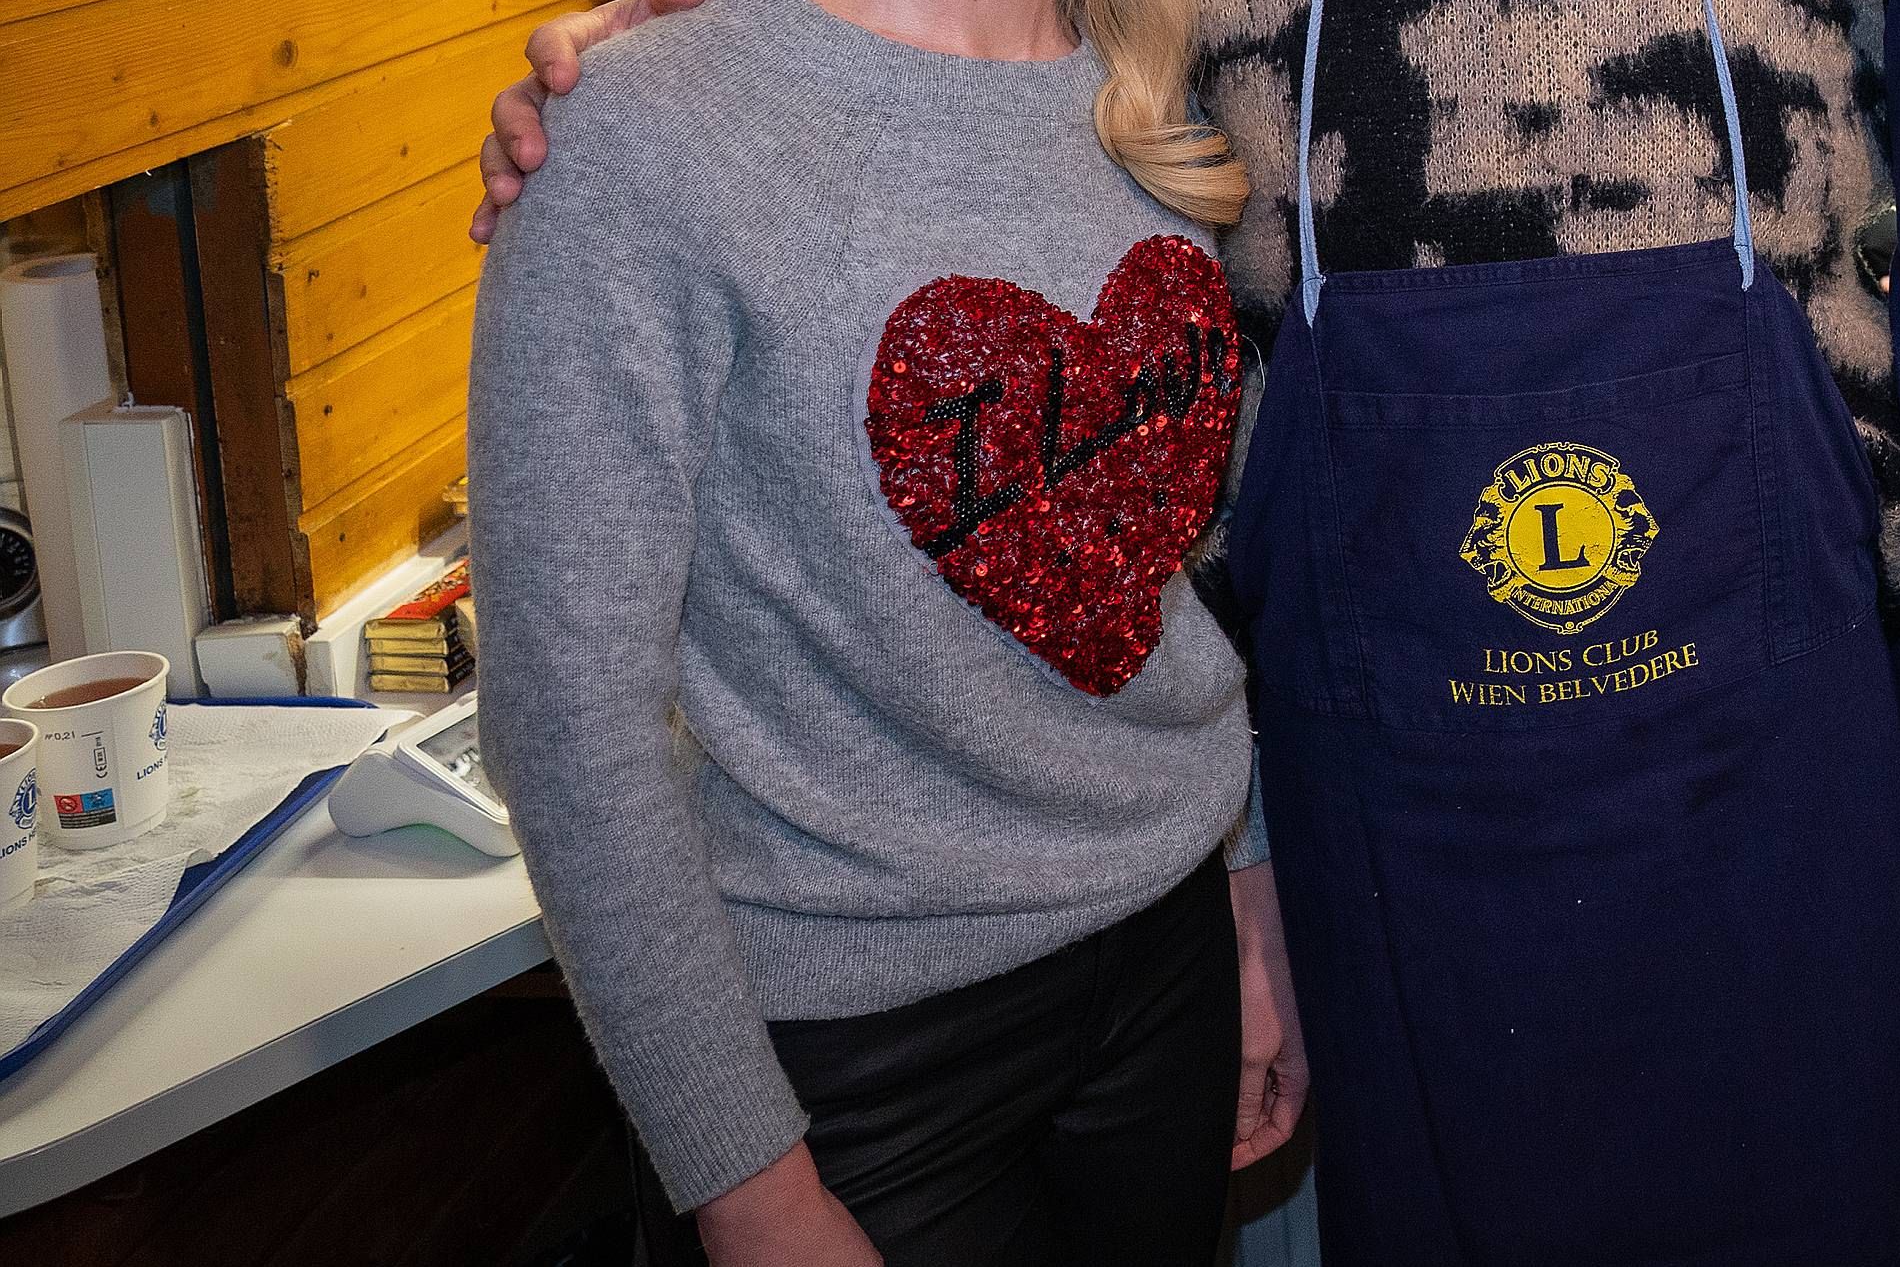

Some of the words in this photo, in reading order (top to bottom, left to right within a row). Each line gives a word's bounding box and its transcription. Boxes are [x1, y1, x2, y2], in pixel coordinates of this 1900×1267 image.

[1505, 452, 1612, 491] LIONS
[1534, 502, 1590, 571] L
[1483, 648, 1573, 674] LIONS
[1582, 629, 1659, 667] CLUB
[1449, 679, 1526, 706] WIEN
[1538, 643, 1699, 704] BELVEDERE
[136, 759, 164, 781] LIONS
